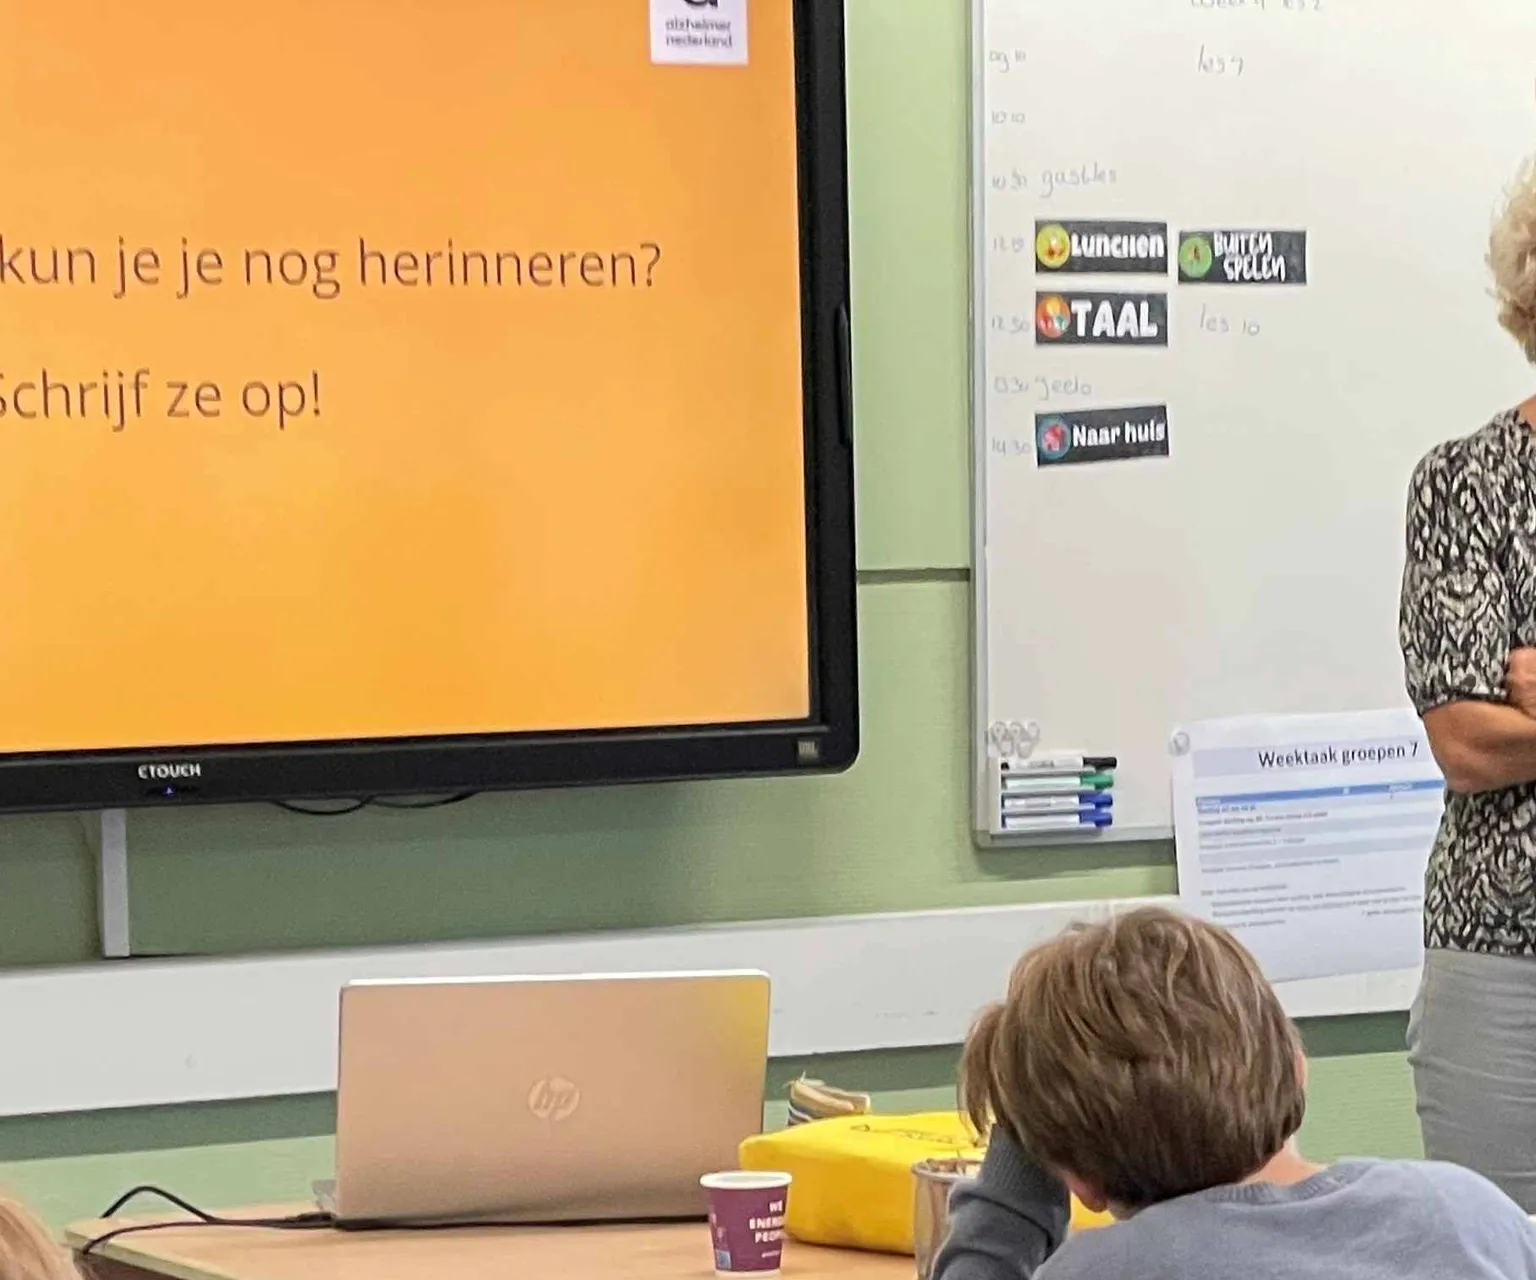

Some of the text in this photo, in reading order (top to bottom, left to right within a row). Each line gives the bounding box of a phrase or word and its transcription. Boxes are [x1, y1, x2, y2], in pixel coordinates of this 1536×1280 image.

[665, 15, 731, 31] alzheimer
[666, 34, 733, 48] nederland
[0, 233, 661, 300] kun je je nog herinneren?
[1071, 300, 1158, 337] TAAL
[167, 381, 222, 418] ze
[242, 369, 321, 431] op!
[1072, 419, 1165, 448] Naar huis
[1258, 740, 1419, 769] Weektaak groepen 7
[528, 1078, 580, 1120] hp
